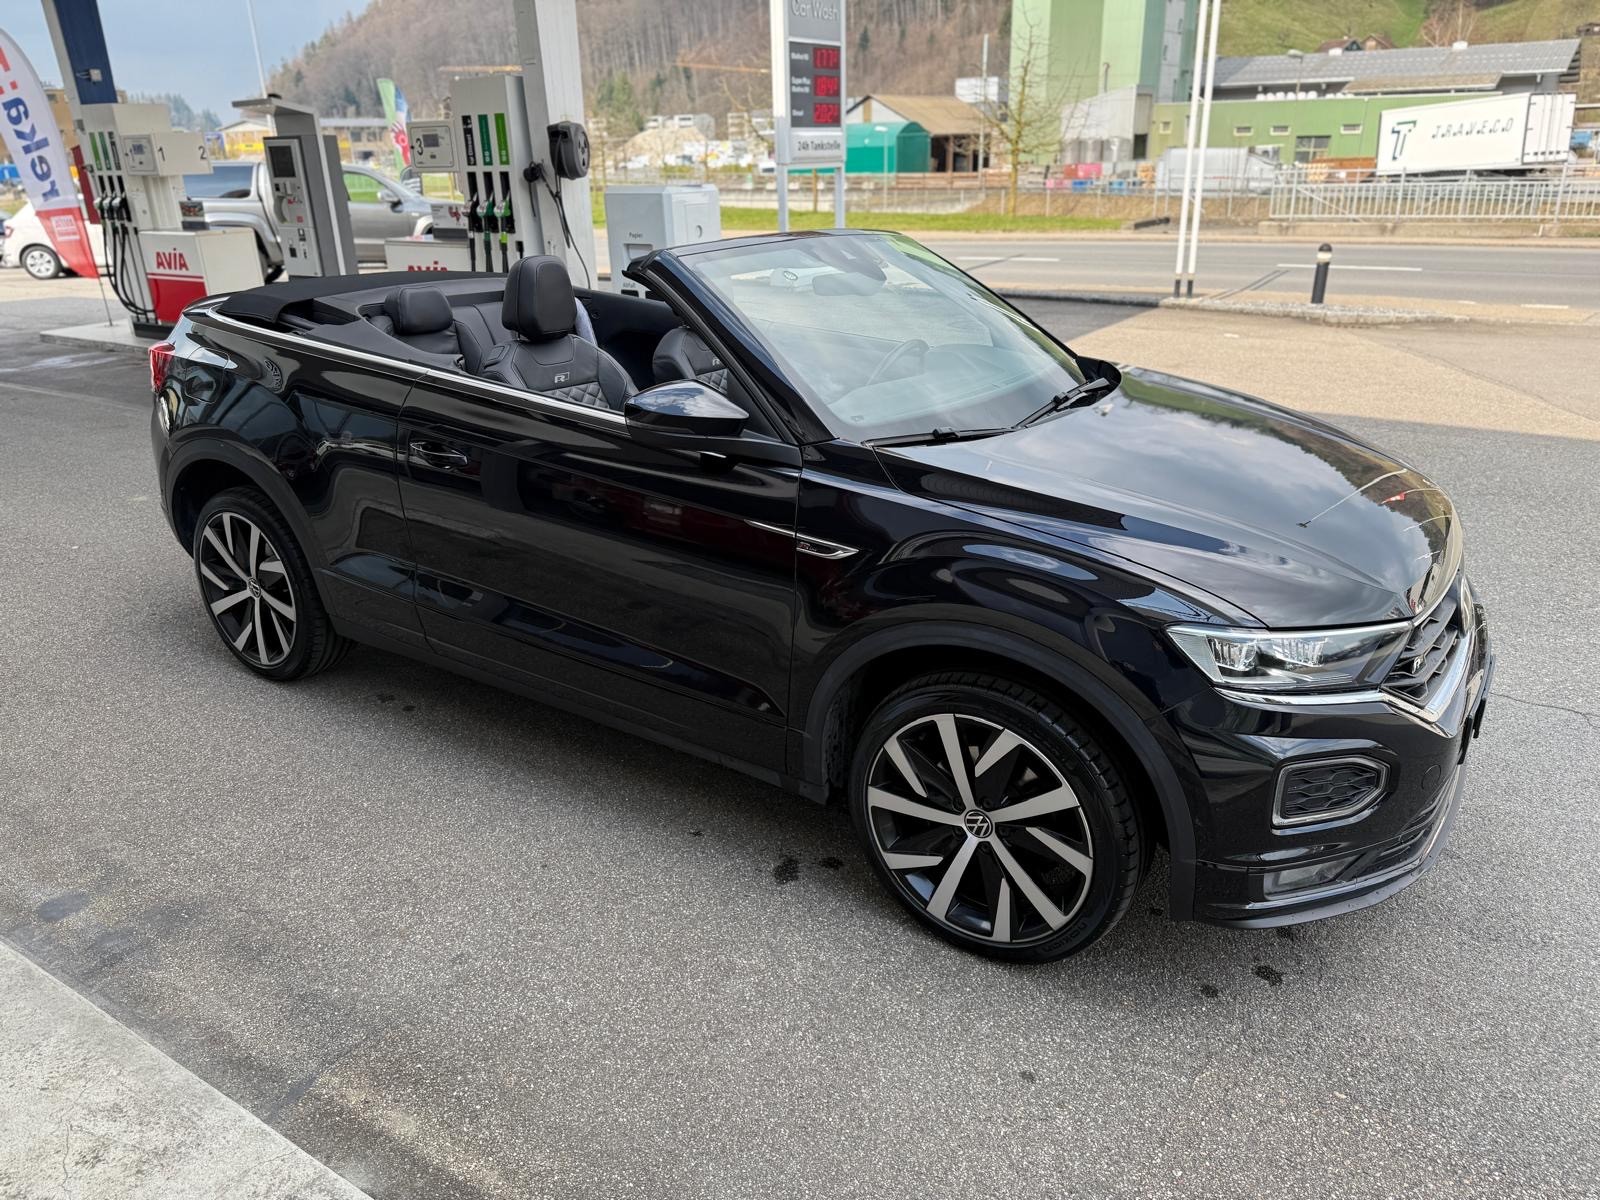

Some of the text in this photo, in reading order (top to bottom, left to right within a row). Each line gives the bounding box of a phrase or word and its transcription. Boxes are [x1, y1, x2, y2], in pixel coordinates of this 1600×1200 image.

[158, 146, 166, 162] 1
[198, 145, 207, 160] 2
[415, 137, 424, 156] 3
